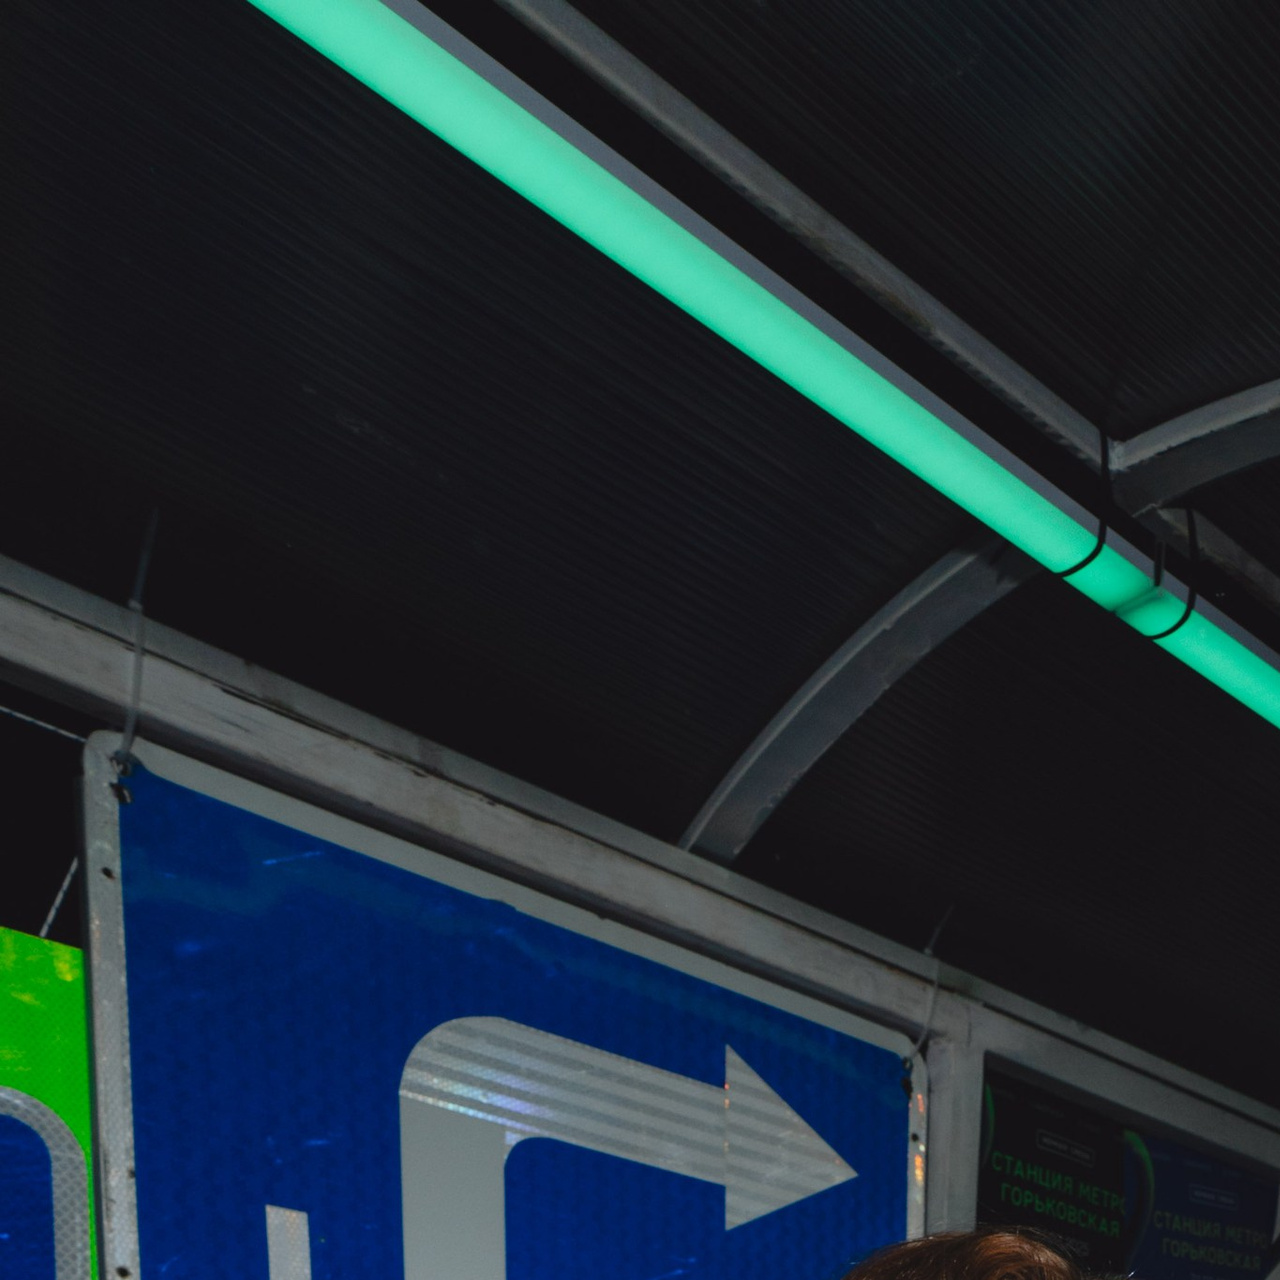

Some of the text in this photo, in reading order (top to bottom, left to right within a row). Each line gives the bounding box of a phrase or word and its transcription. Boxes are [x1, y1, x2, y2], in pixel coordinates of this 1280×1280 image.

[991, 1150, 1074, 1195] СТАНЦИЯ
[1003, 1182, 1120, 1238] ГОРЬКОВСКАЯ
[1153, 1210, 1269, 1249] СТАНЦИЯ МЕТРО
[1162, 1237, 1262, 1271] ГОРЬКОВСКАЯ
